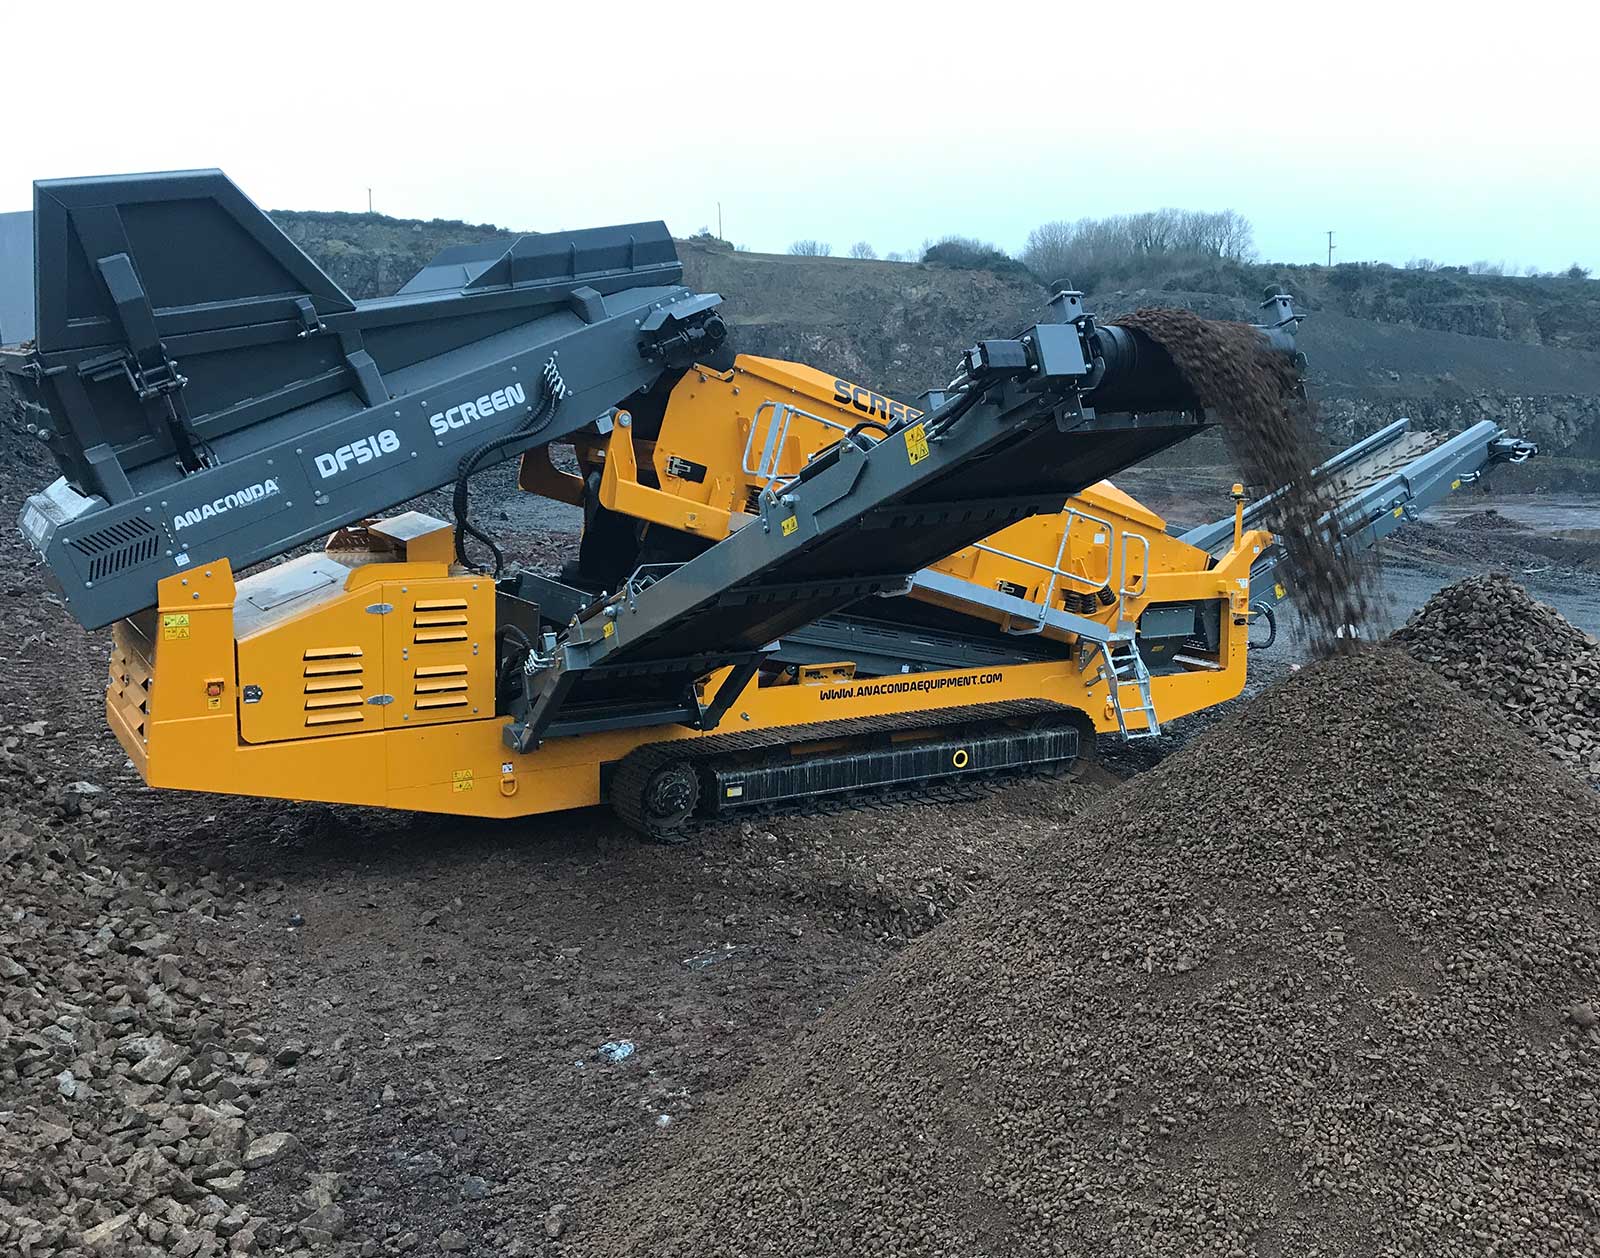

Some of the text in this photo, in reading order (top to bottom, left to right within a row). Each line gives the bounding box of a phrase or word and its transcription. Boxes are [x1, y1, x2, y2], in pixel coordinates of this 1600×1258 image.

[173, 382, 526, 531] ANACONDA DF518 SCREEN
[820, 672, 1003, 701] WWW.ANACONDAEQUIPMENT.COM
